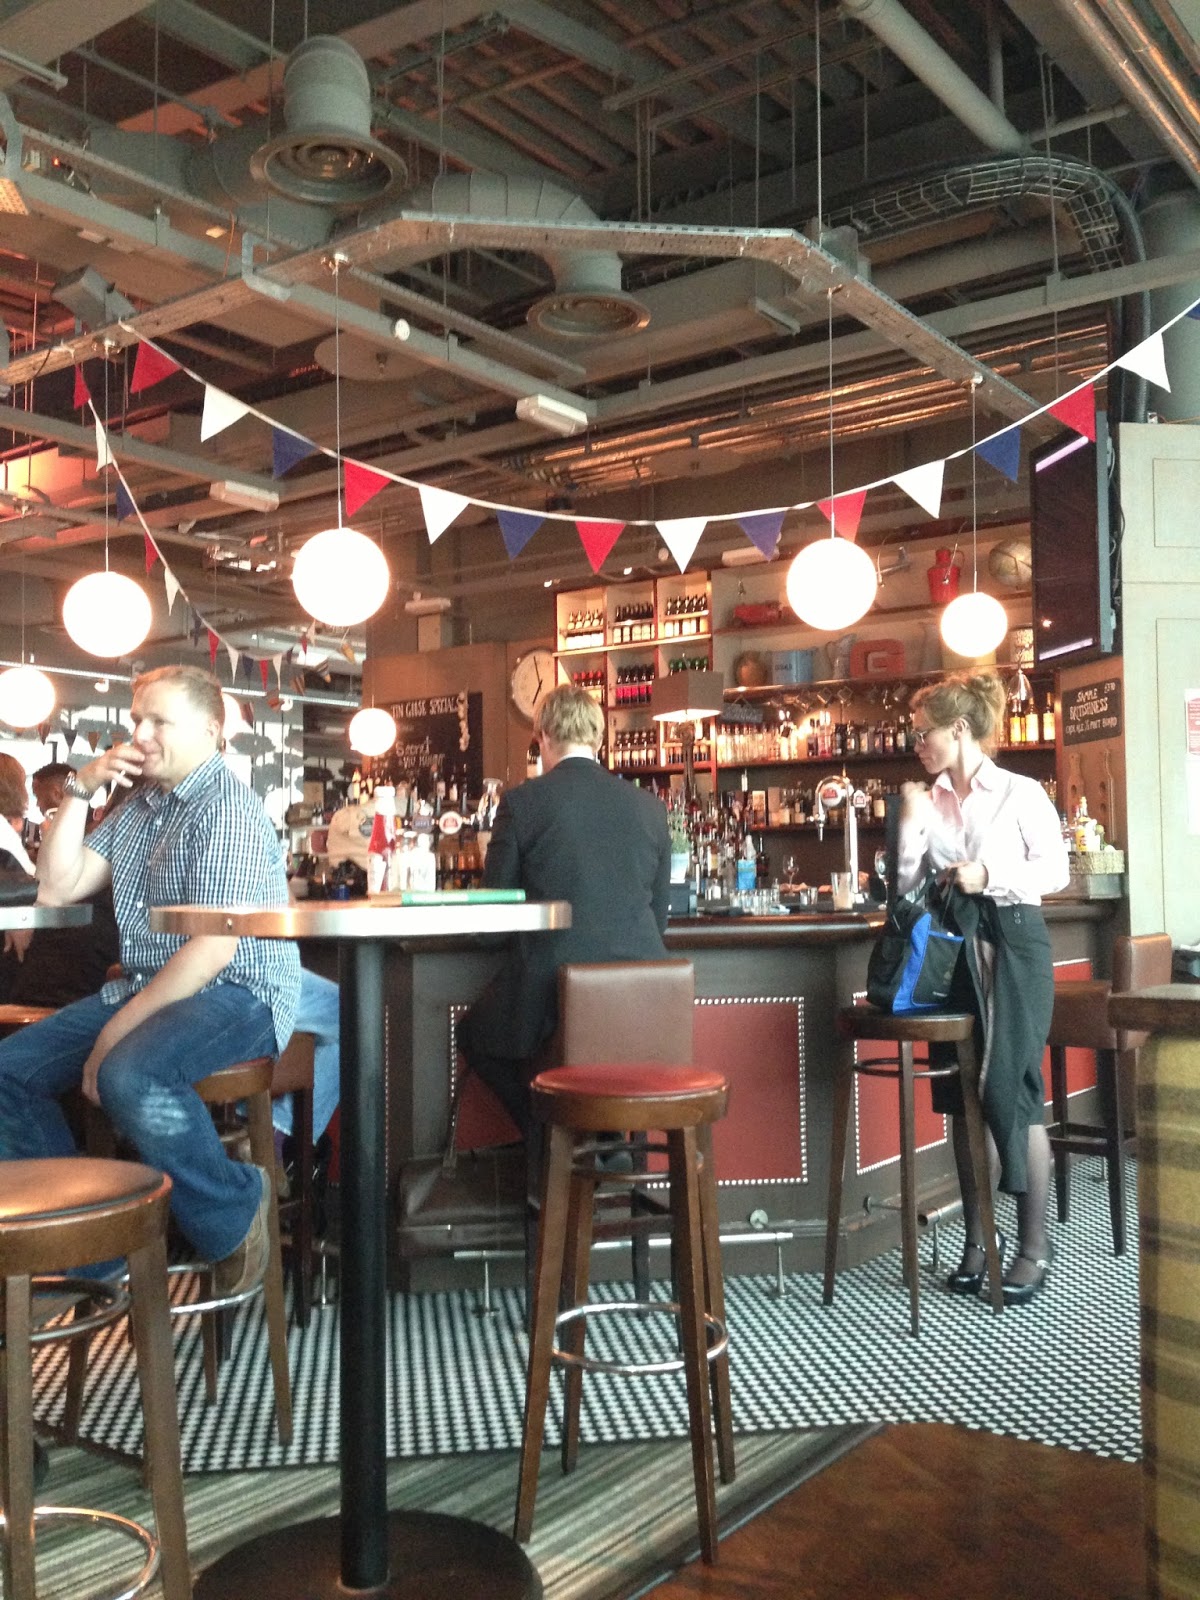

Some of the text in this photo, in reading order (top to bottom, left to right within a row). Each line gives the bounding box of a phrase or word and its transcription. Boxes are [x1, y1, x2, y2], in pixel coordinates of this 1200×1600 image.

[391, 704, 404, 719] TIN
[405, 700, 427, 718] GOOSE
[1070, 697, 1108, 721] BRITISHNESS
